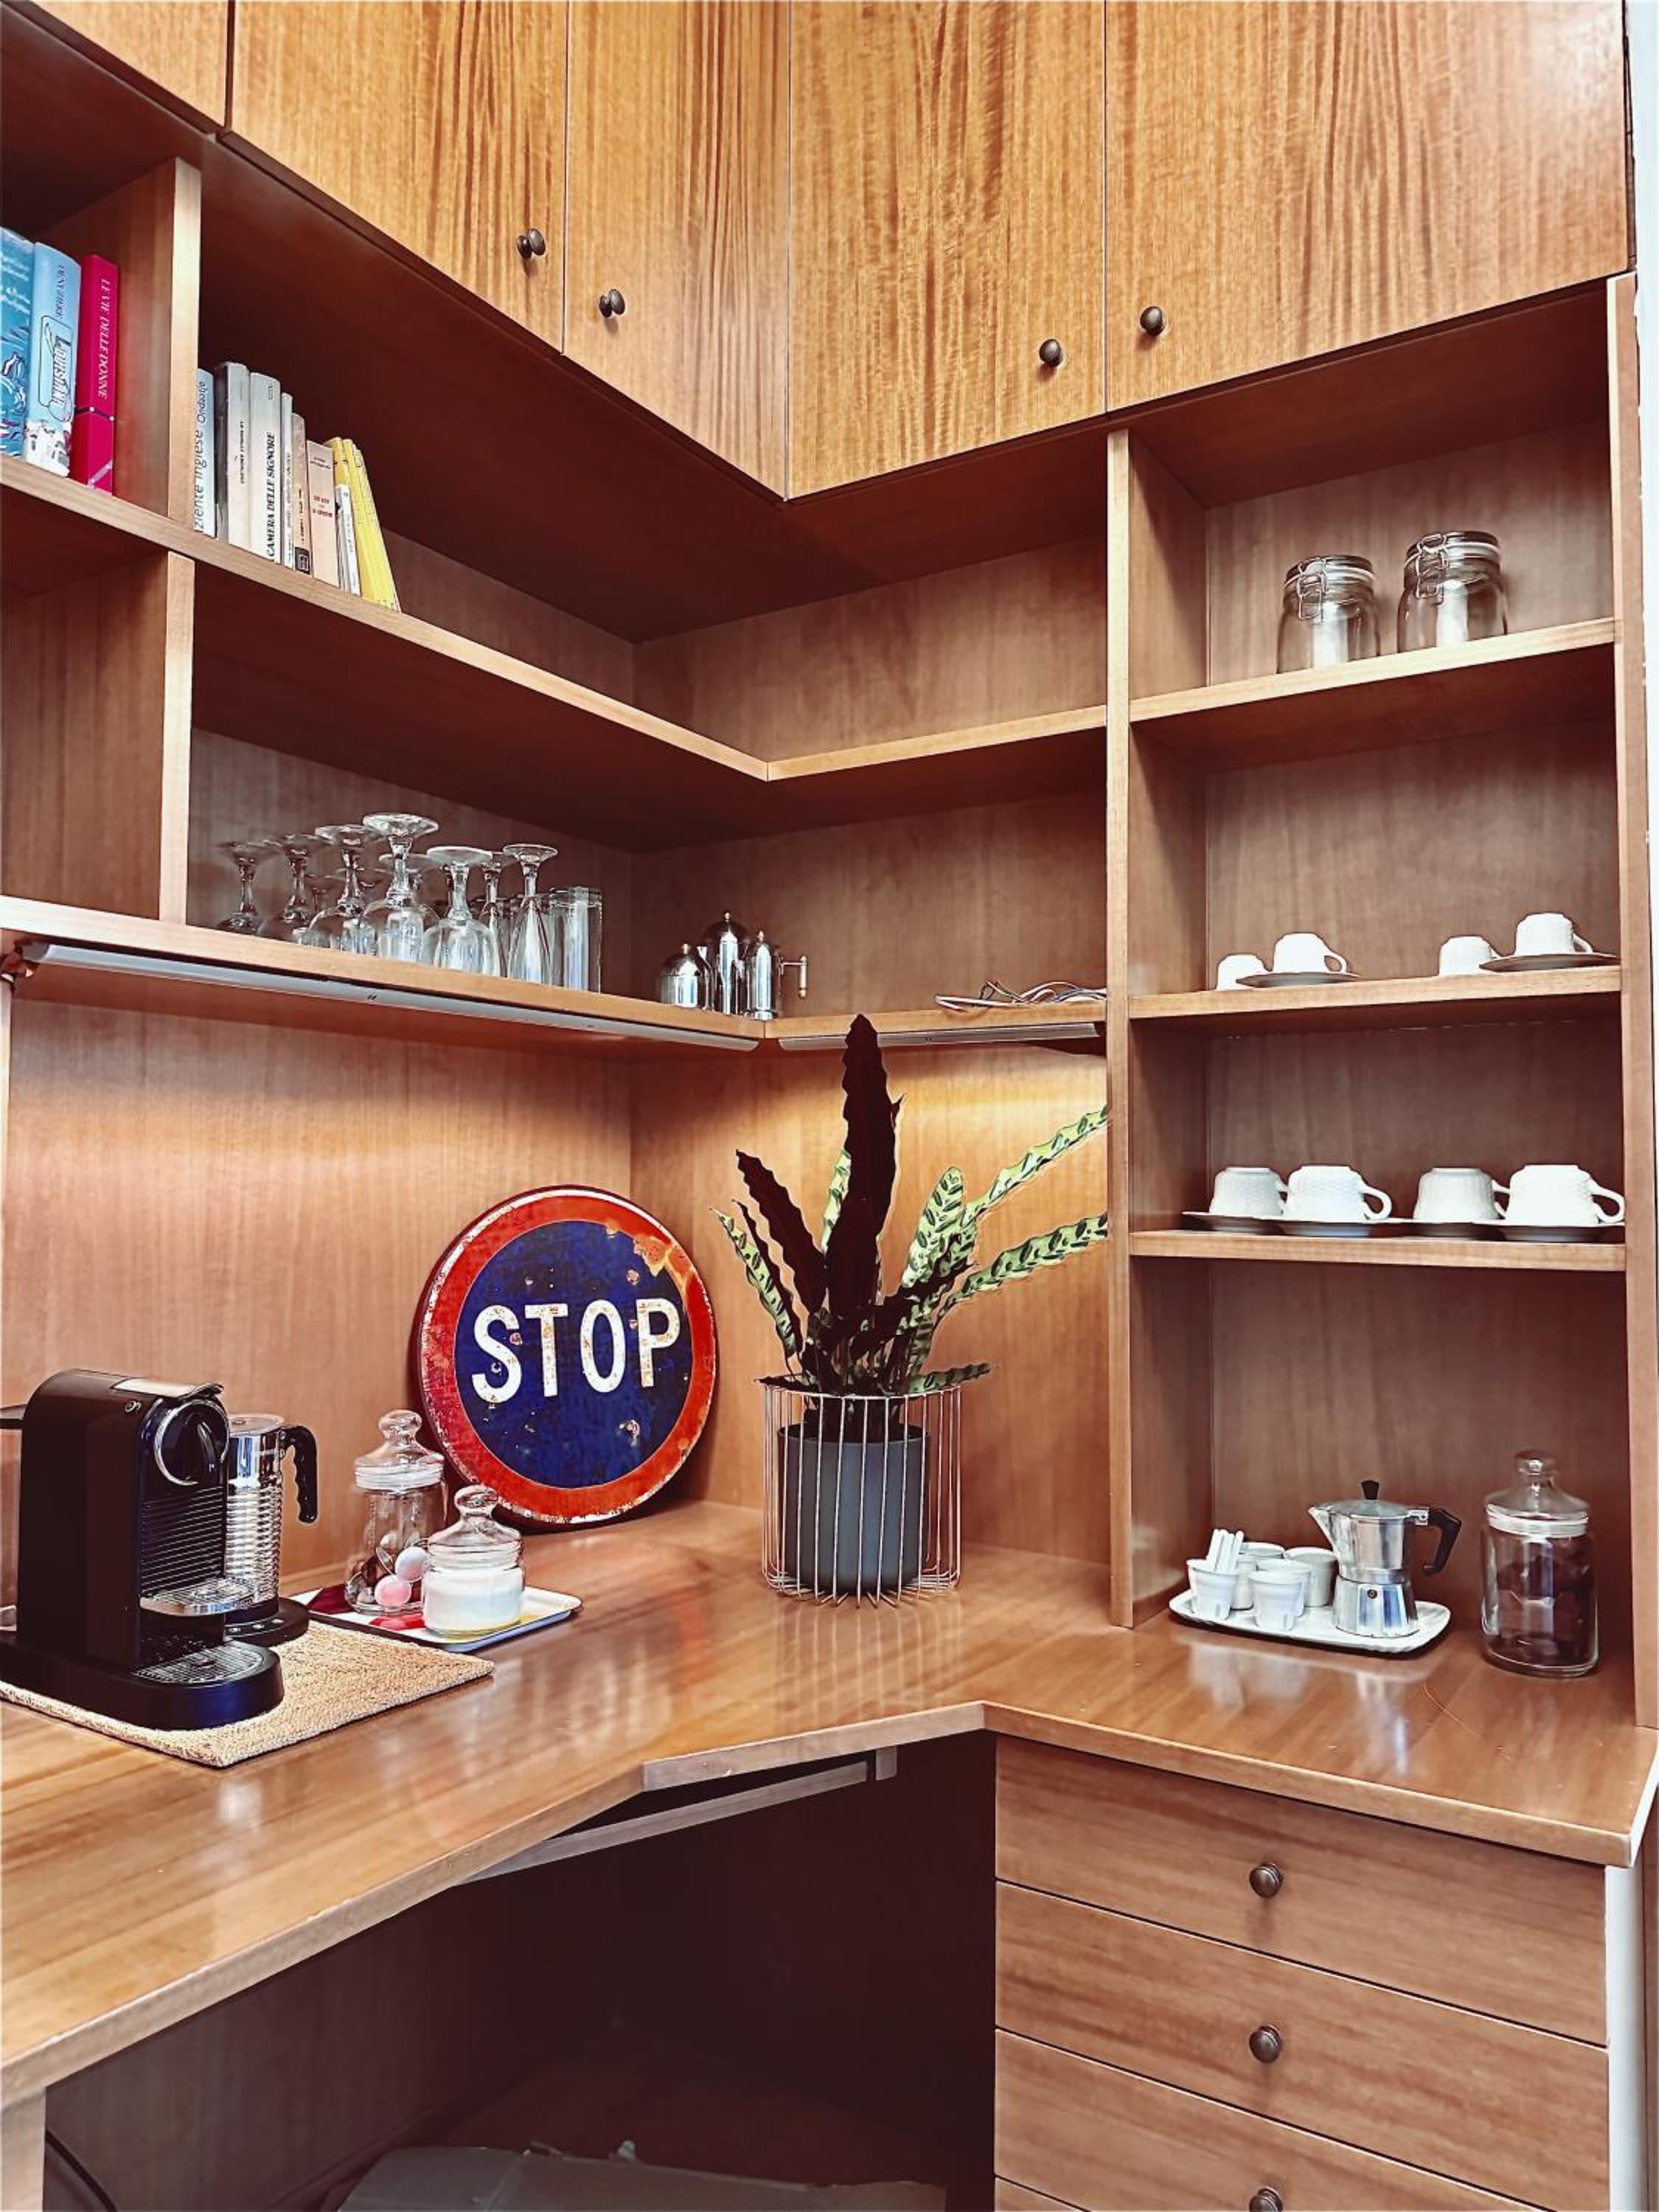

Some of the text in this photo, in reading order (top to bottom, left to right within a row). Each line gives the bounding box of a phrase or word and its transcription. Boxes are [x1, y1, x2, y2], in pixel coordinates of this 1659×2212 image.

[98, 278, 111, 399] LE VIE DELLE DONNE
[265, 432, 276, 557] CAMERA DELLE SIGNORE
[472, 1298, 681, 1403] STOP
